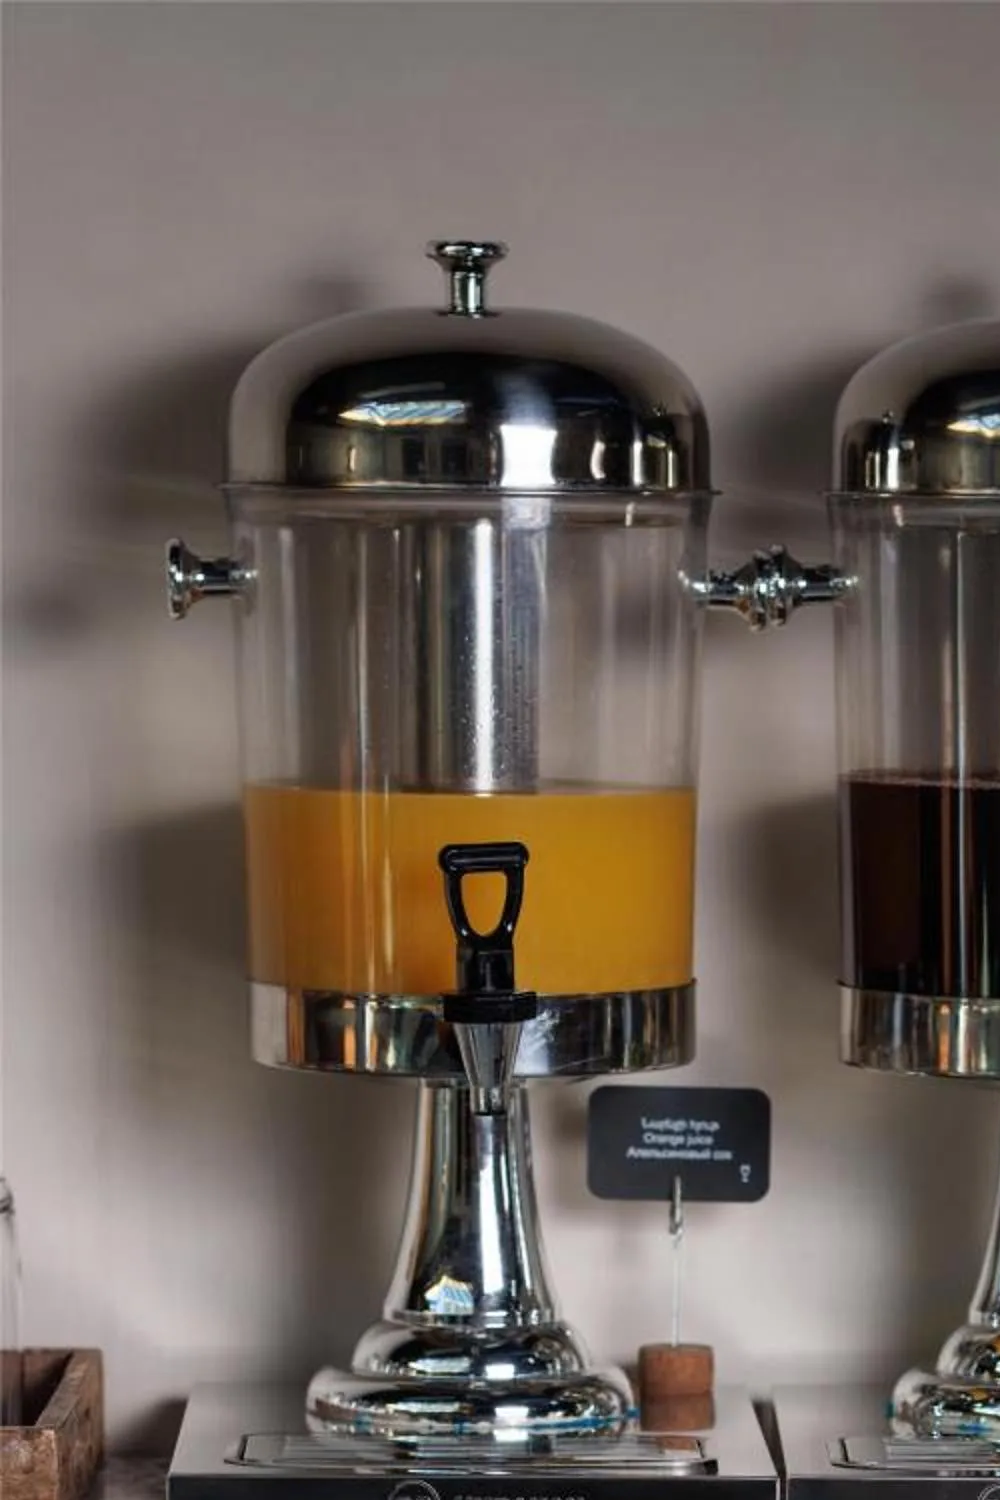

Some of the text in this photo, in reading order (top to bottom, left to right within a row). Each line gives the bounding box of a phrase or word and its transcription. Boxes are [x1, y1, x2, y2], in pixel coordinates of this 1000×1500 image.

[643, 1132, 714, 1148] Orange juice
[626, 1146, 733, 1160] Апельсиновый сок
